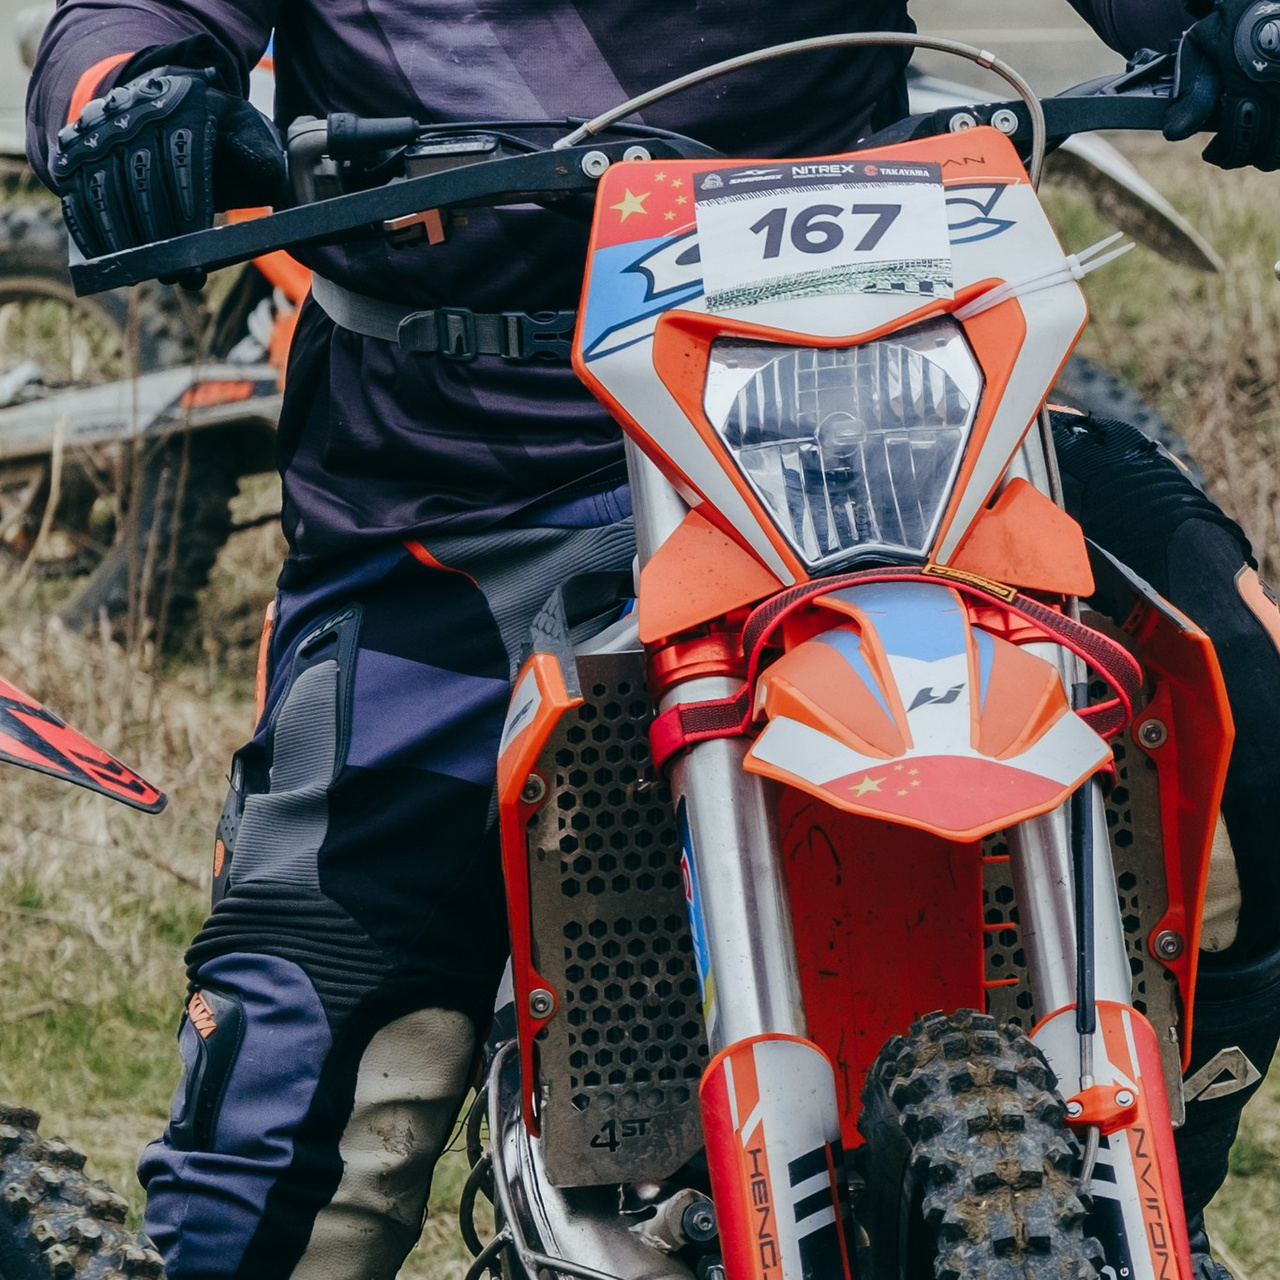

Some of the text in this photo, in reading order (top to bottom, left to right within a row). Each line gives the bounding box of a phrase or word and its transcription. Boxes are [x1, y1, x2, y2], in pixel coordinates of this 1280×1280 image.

[792, 164, 855, 176] NITREX
[879, 168, 930, 178] TAKAYAMA
[750, 204, 902, 259] 167
